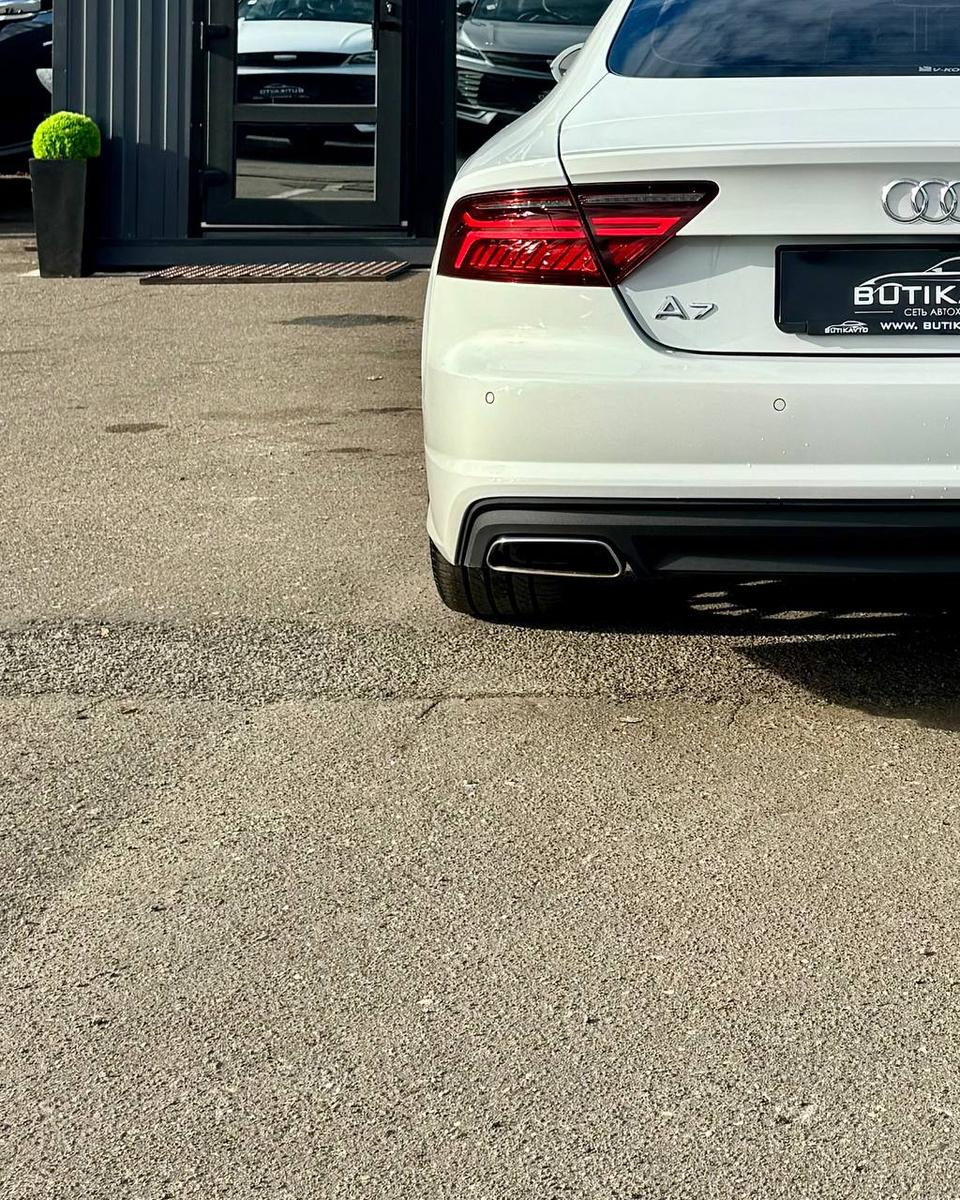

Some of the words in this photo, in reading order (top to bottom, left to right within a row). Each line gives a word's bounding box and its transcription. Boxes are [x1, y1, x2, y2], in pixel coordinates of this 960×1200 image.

[655, 295, 718, 320] A7
[904, 308, 928, 316] СЕТЬ
[880, 321, 918, 330] WWW.
